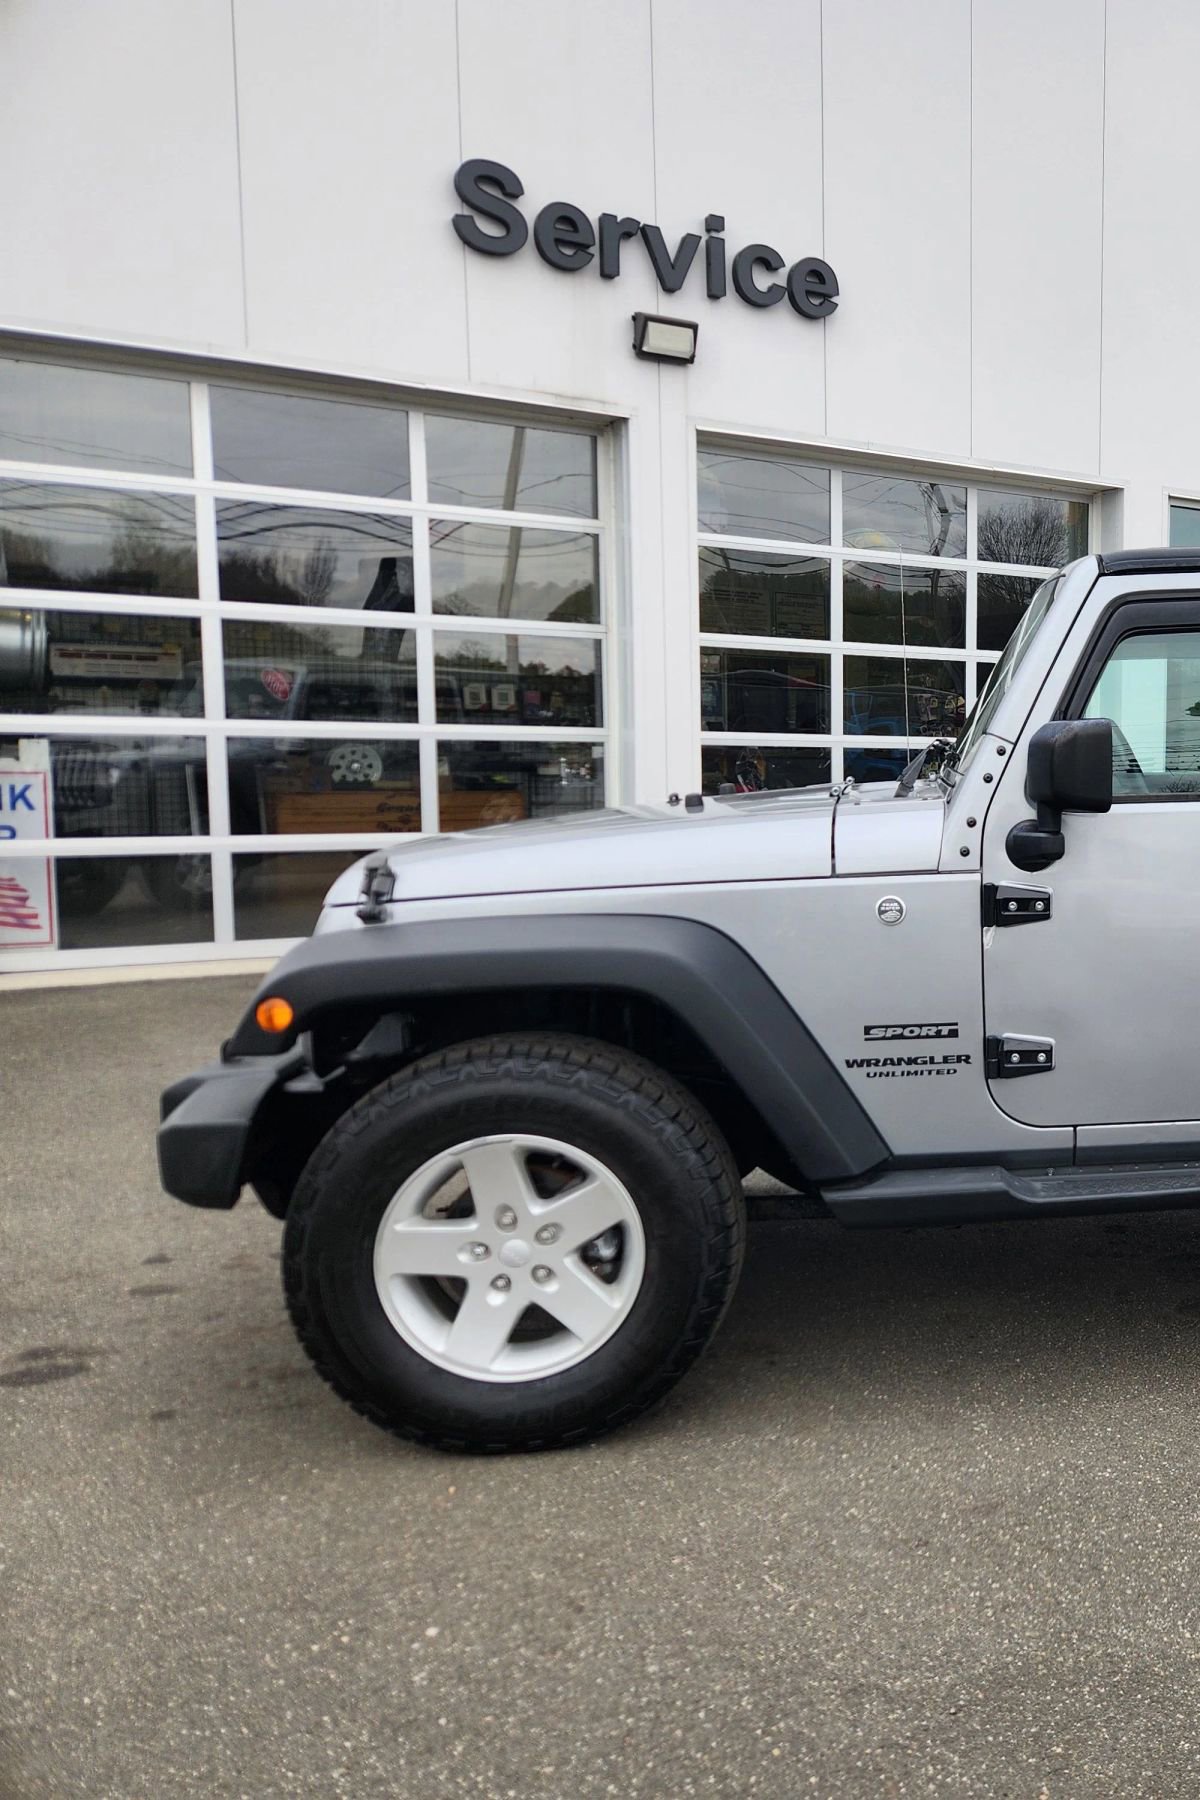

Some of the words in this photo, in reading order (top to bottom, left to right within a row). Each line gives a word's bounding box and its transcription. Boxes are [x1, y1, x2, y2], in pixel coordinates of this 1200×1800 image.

[452, 159, 840, 319] Service
[864, 1025, 958, 1039] SPORT
[845, 1054, 972, 1068] WRANGLER
[867, 1069, 957, 1078] UNLIMITED
